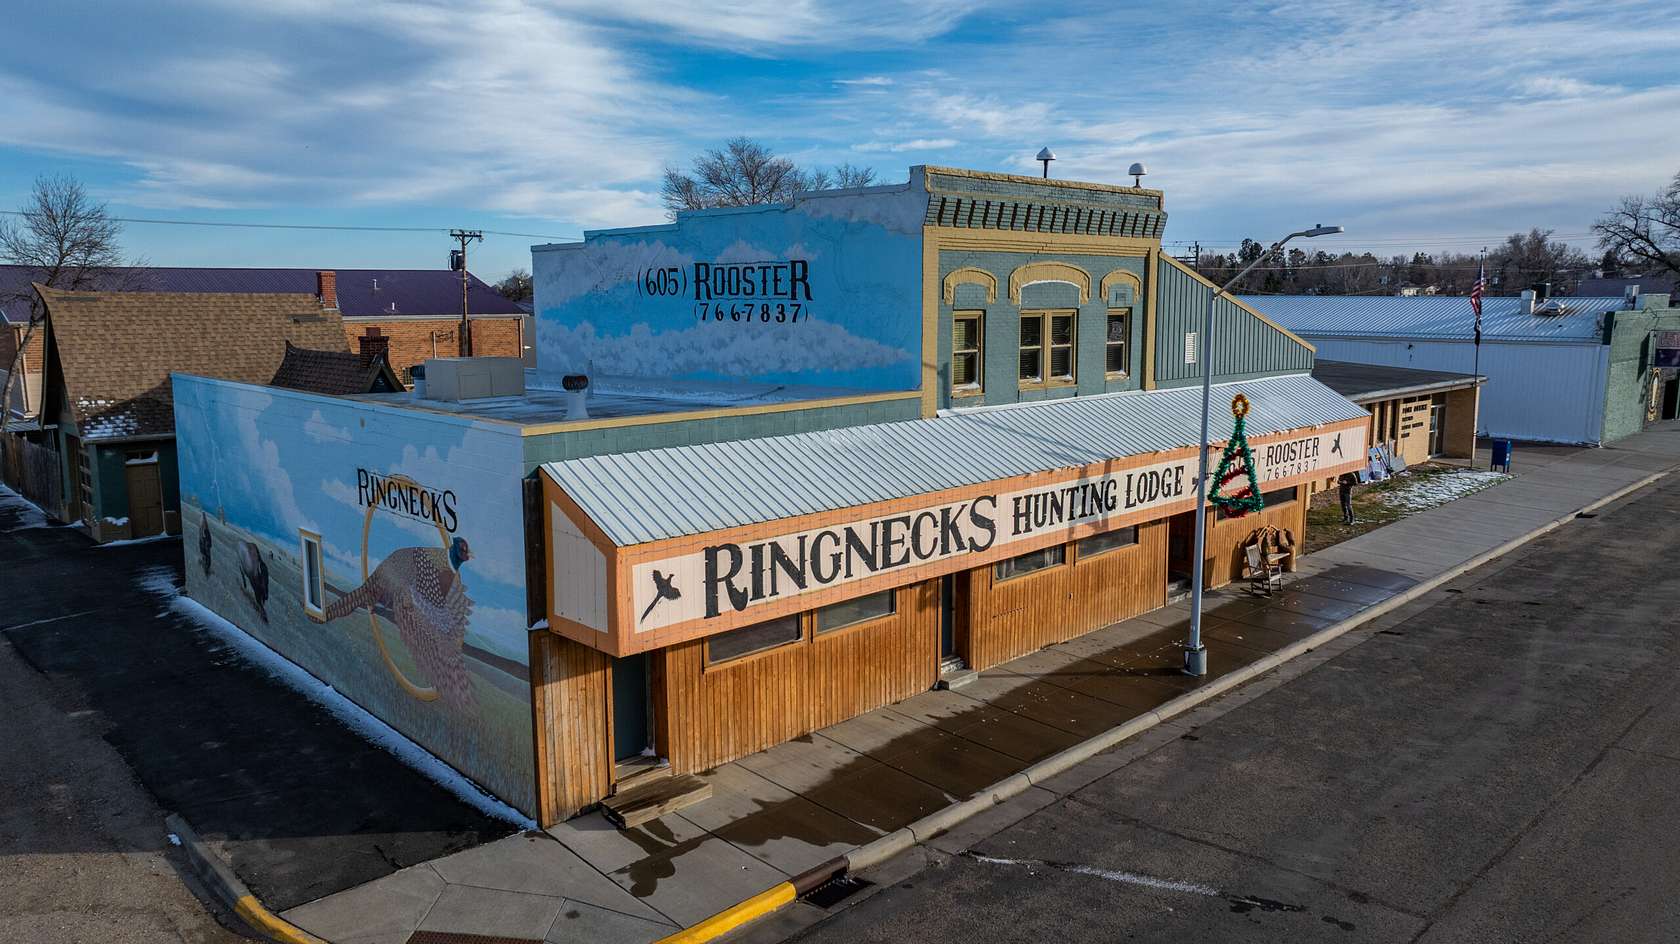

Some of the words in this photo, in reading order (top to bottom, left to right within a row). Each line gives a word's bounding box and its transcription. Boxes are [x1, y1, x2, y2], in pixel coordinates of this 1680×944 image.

[637, 264, 687, 297] (605)
[694, 260, 813, 301] ROOSTER
[357, 468, 457, 533] RINGNECKS
[703, 495, 997, 619] RINGNECKS
[1012, 478, 1117, 536] HUNTING
[1124, 465, 1185, 509] LODGE
